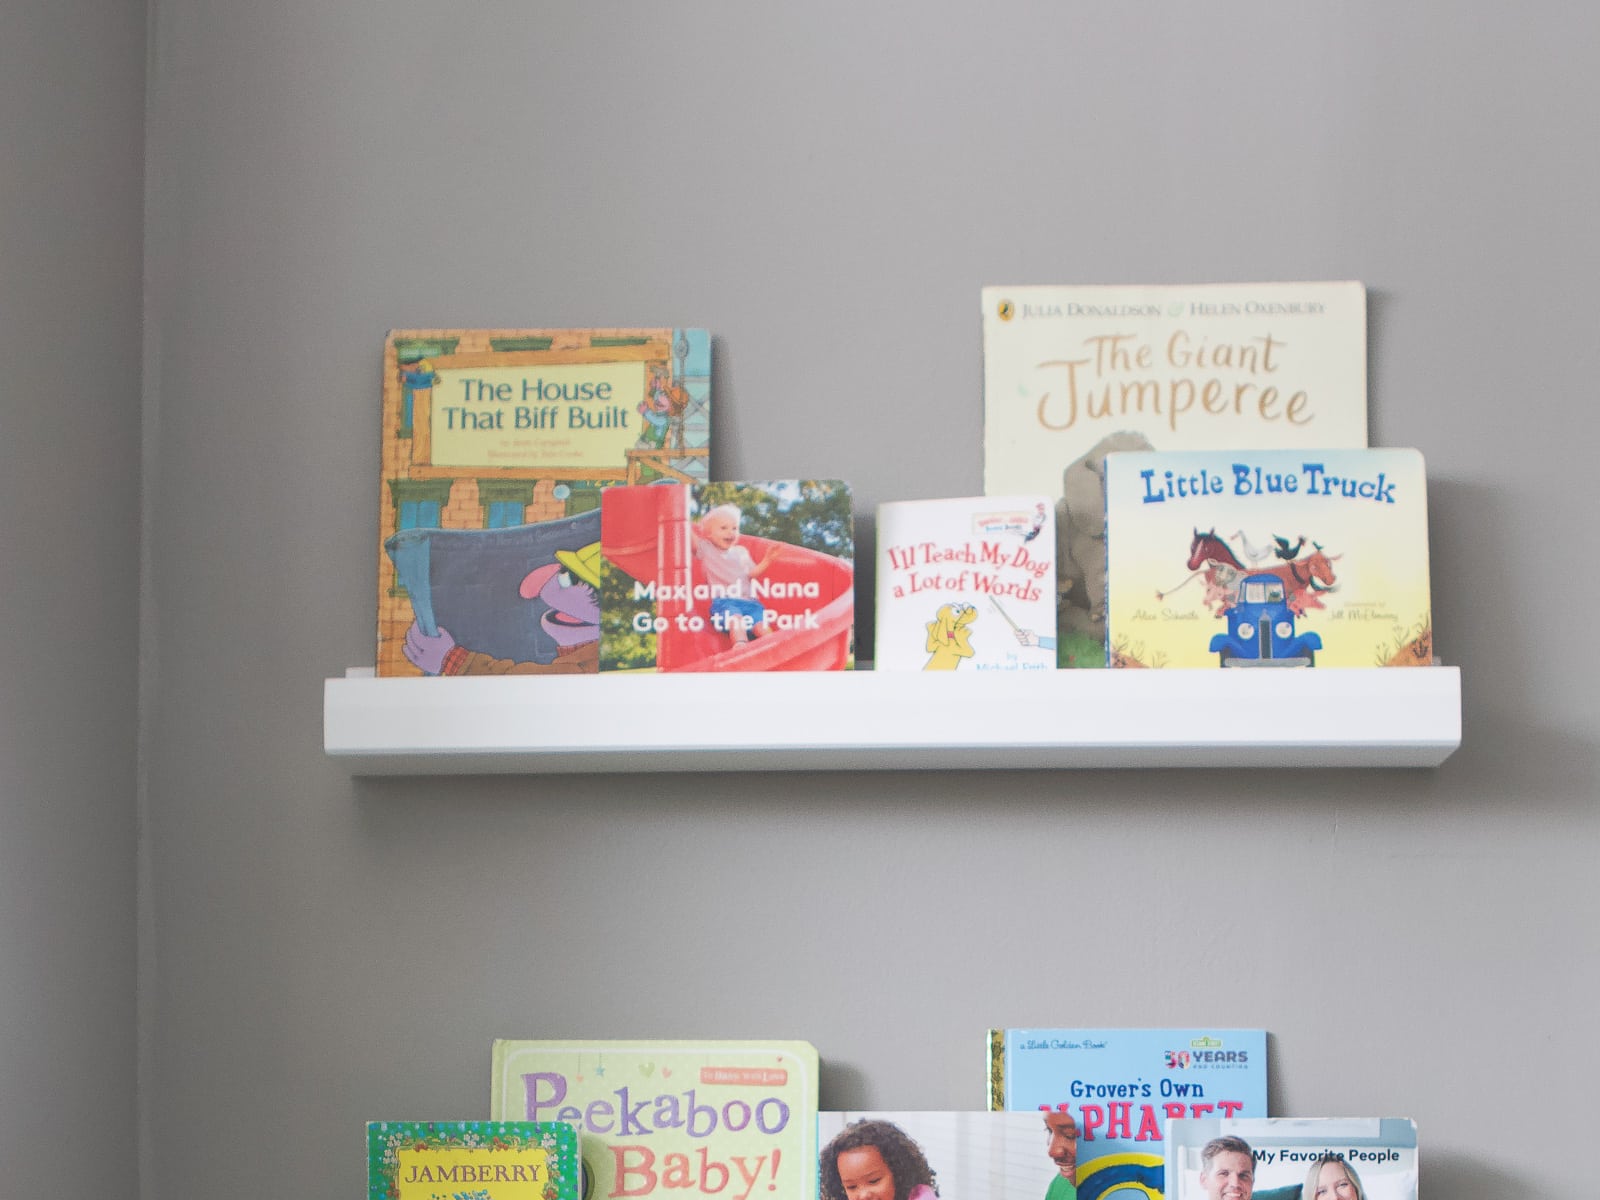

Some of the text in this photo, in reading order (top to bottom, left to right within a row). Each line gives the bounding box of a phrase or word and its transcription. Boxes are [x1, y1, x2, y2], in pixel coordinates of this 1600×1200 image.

[1022, 303, 1062, 320] JULIA
[1067, 302, 1161, 317] DONALDSON
[1189, 301, 1241, 316] HELEN
[1083, 328, 1288, 378] The Giant
[458, 377, 613, 401] The House
[1034, 357, 1316, 432] Jumperee
[441, 405, 629, 430] That Biff Built
[1140, 462, 1396, 504] Little Blue Truck
[886, 540, 1052, 579] I'll Teach My Dog
[633, 577, 820, 601] Max and Nana
[892, 569, 1043, 603] a Lot of Words
[632, 608, 820, 633] Go to the Park
[1192, 1050, 1249, 1063] YEARS
[1070, 1077, 1205, 1098] Grover's Own
[520, 1071, 790, 1138] Peekaboo
[1252, 1148, 1400, 1165] My Favorite People
[404, 1163, 541, 1184] JAMBERRY
